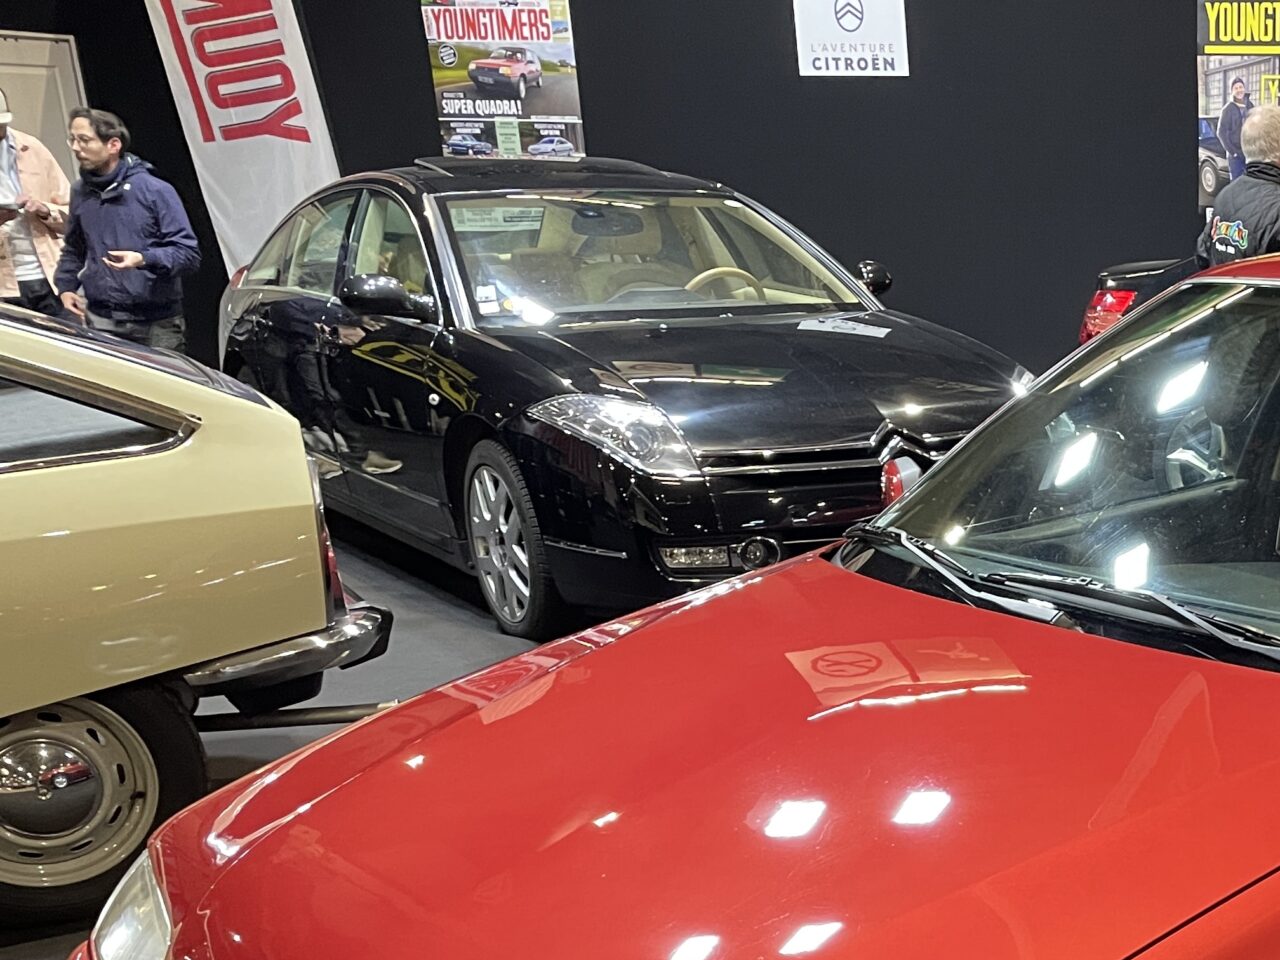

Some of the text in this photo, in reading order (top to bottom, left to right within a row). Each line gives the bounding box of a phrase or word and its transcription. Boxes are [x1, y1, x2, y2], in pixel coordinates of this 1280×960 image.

[430, 8, 551, 41] YOUNGTIMERS
[810, 43, 895, 53] L'AVENTURE
[812, 54, 896, 71] CITROËN
[441, 99, 475, 114] SUPER
